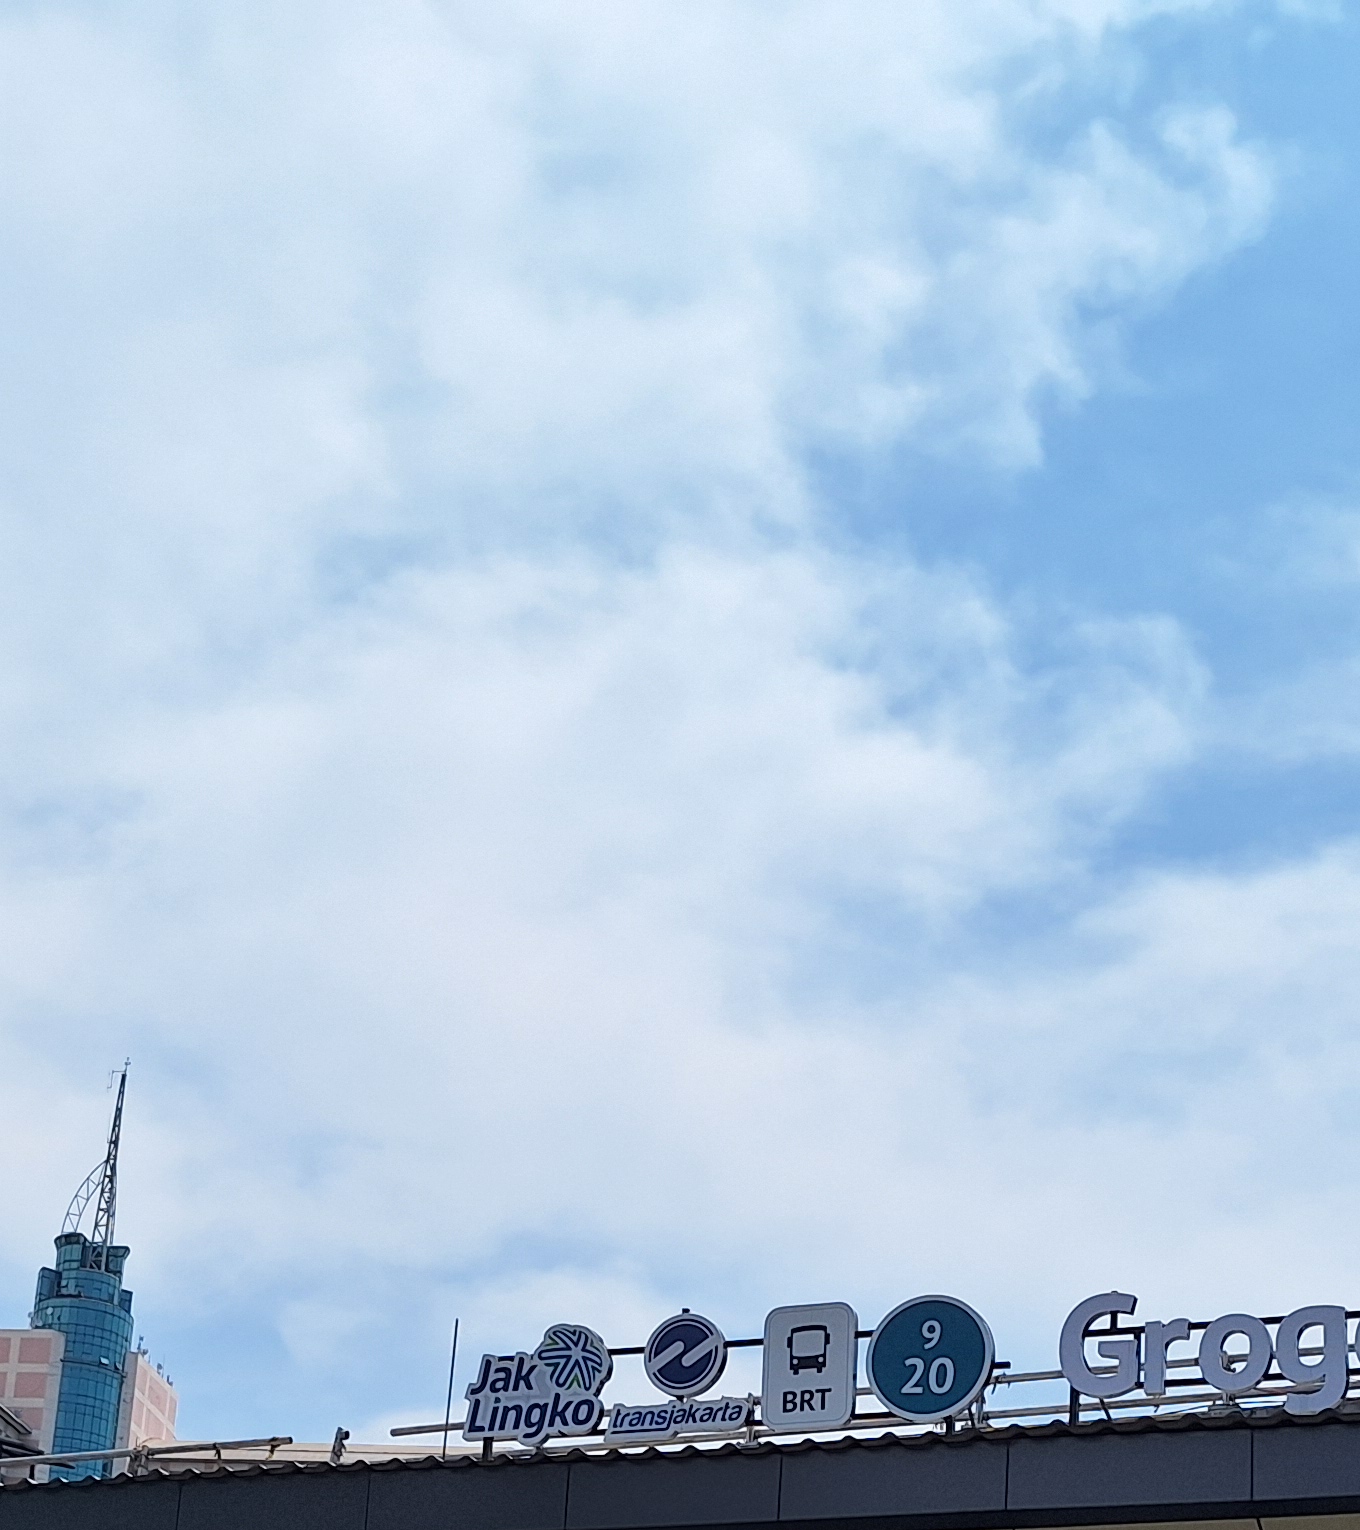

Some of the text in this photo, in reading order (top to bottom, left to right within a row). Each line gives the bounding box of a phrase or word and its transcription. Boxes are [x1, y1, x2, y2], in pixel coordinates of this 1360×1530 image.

[920, 1319, 942, 1350] 9
[470, 1356, 538, 1394] Jak
[900, 1356, 955, 1395] 20
[467, 1393, 596, 1439] Lingko
[610, 1401, 743, 1434] transjakarta
[781, 1387, 832, 1414] BRT
